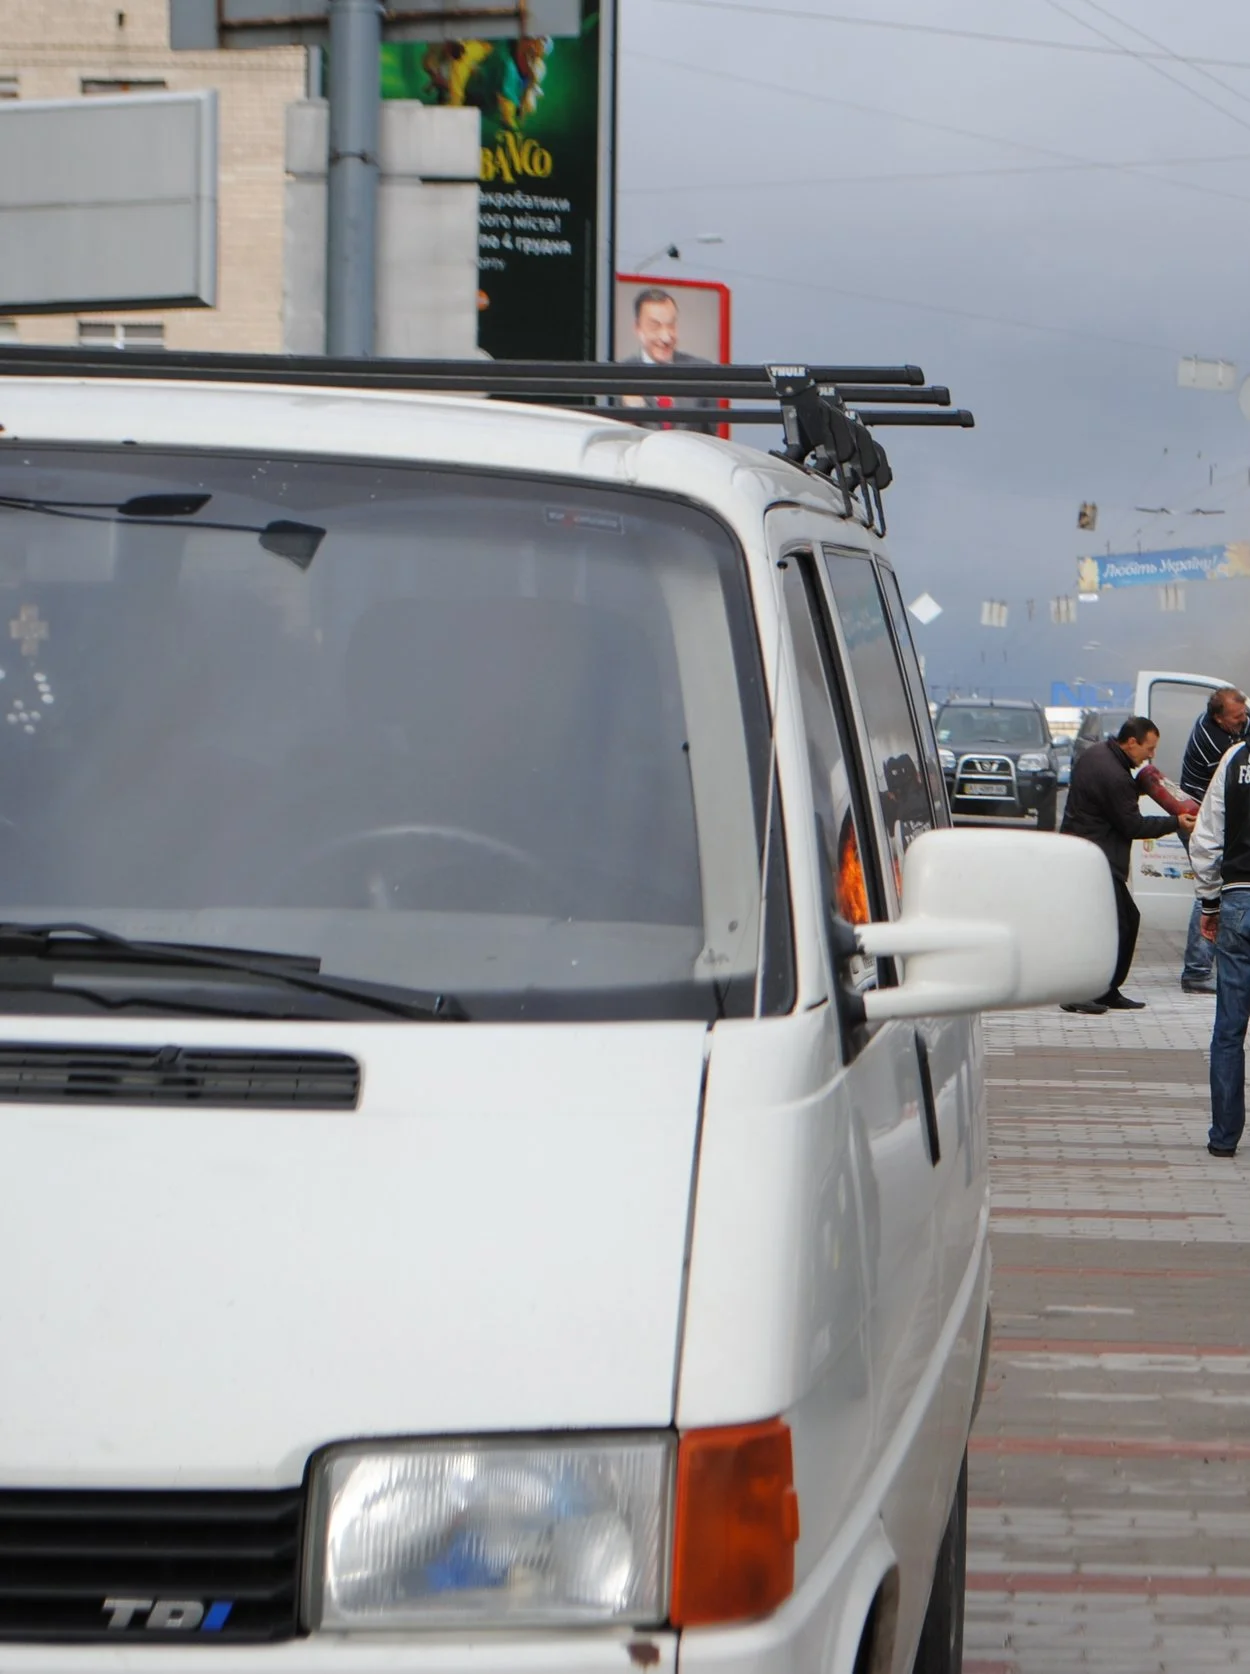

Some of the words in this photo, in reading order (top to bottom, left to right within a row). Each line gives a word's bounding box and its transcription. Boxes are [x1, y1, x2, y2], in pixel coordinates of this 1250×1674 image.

[515, 236, 572, 256] грудня
[770, 365, 806, 377] THULE
[102, 1597, 234, 1631] TDI
